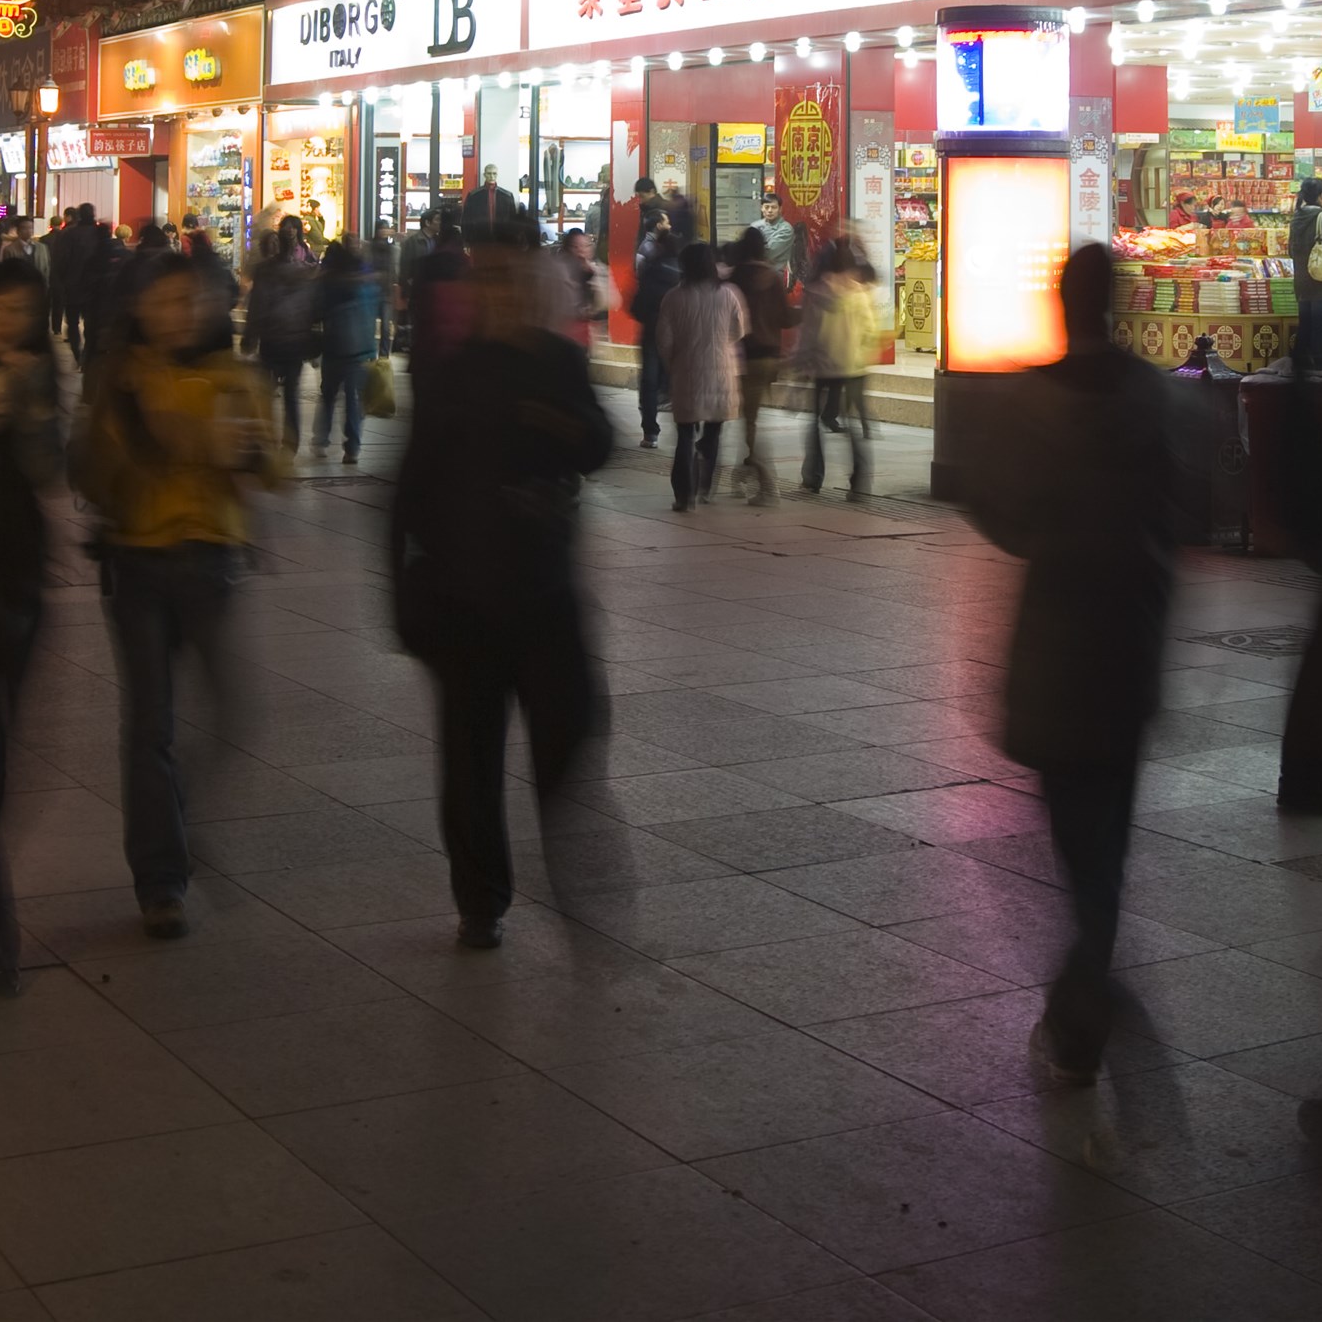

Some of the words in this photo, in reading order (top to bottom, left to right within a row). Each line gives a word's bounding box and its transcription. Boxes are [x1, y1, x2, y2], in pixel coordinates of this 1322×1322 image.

[329, 47, 362, 69] ITALY
[791, 127, 821, 153] 南京
[790, 154, 821, 181] 特产
